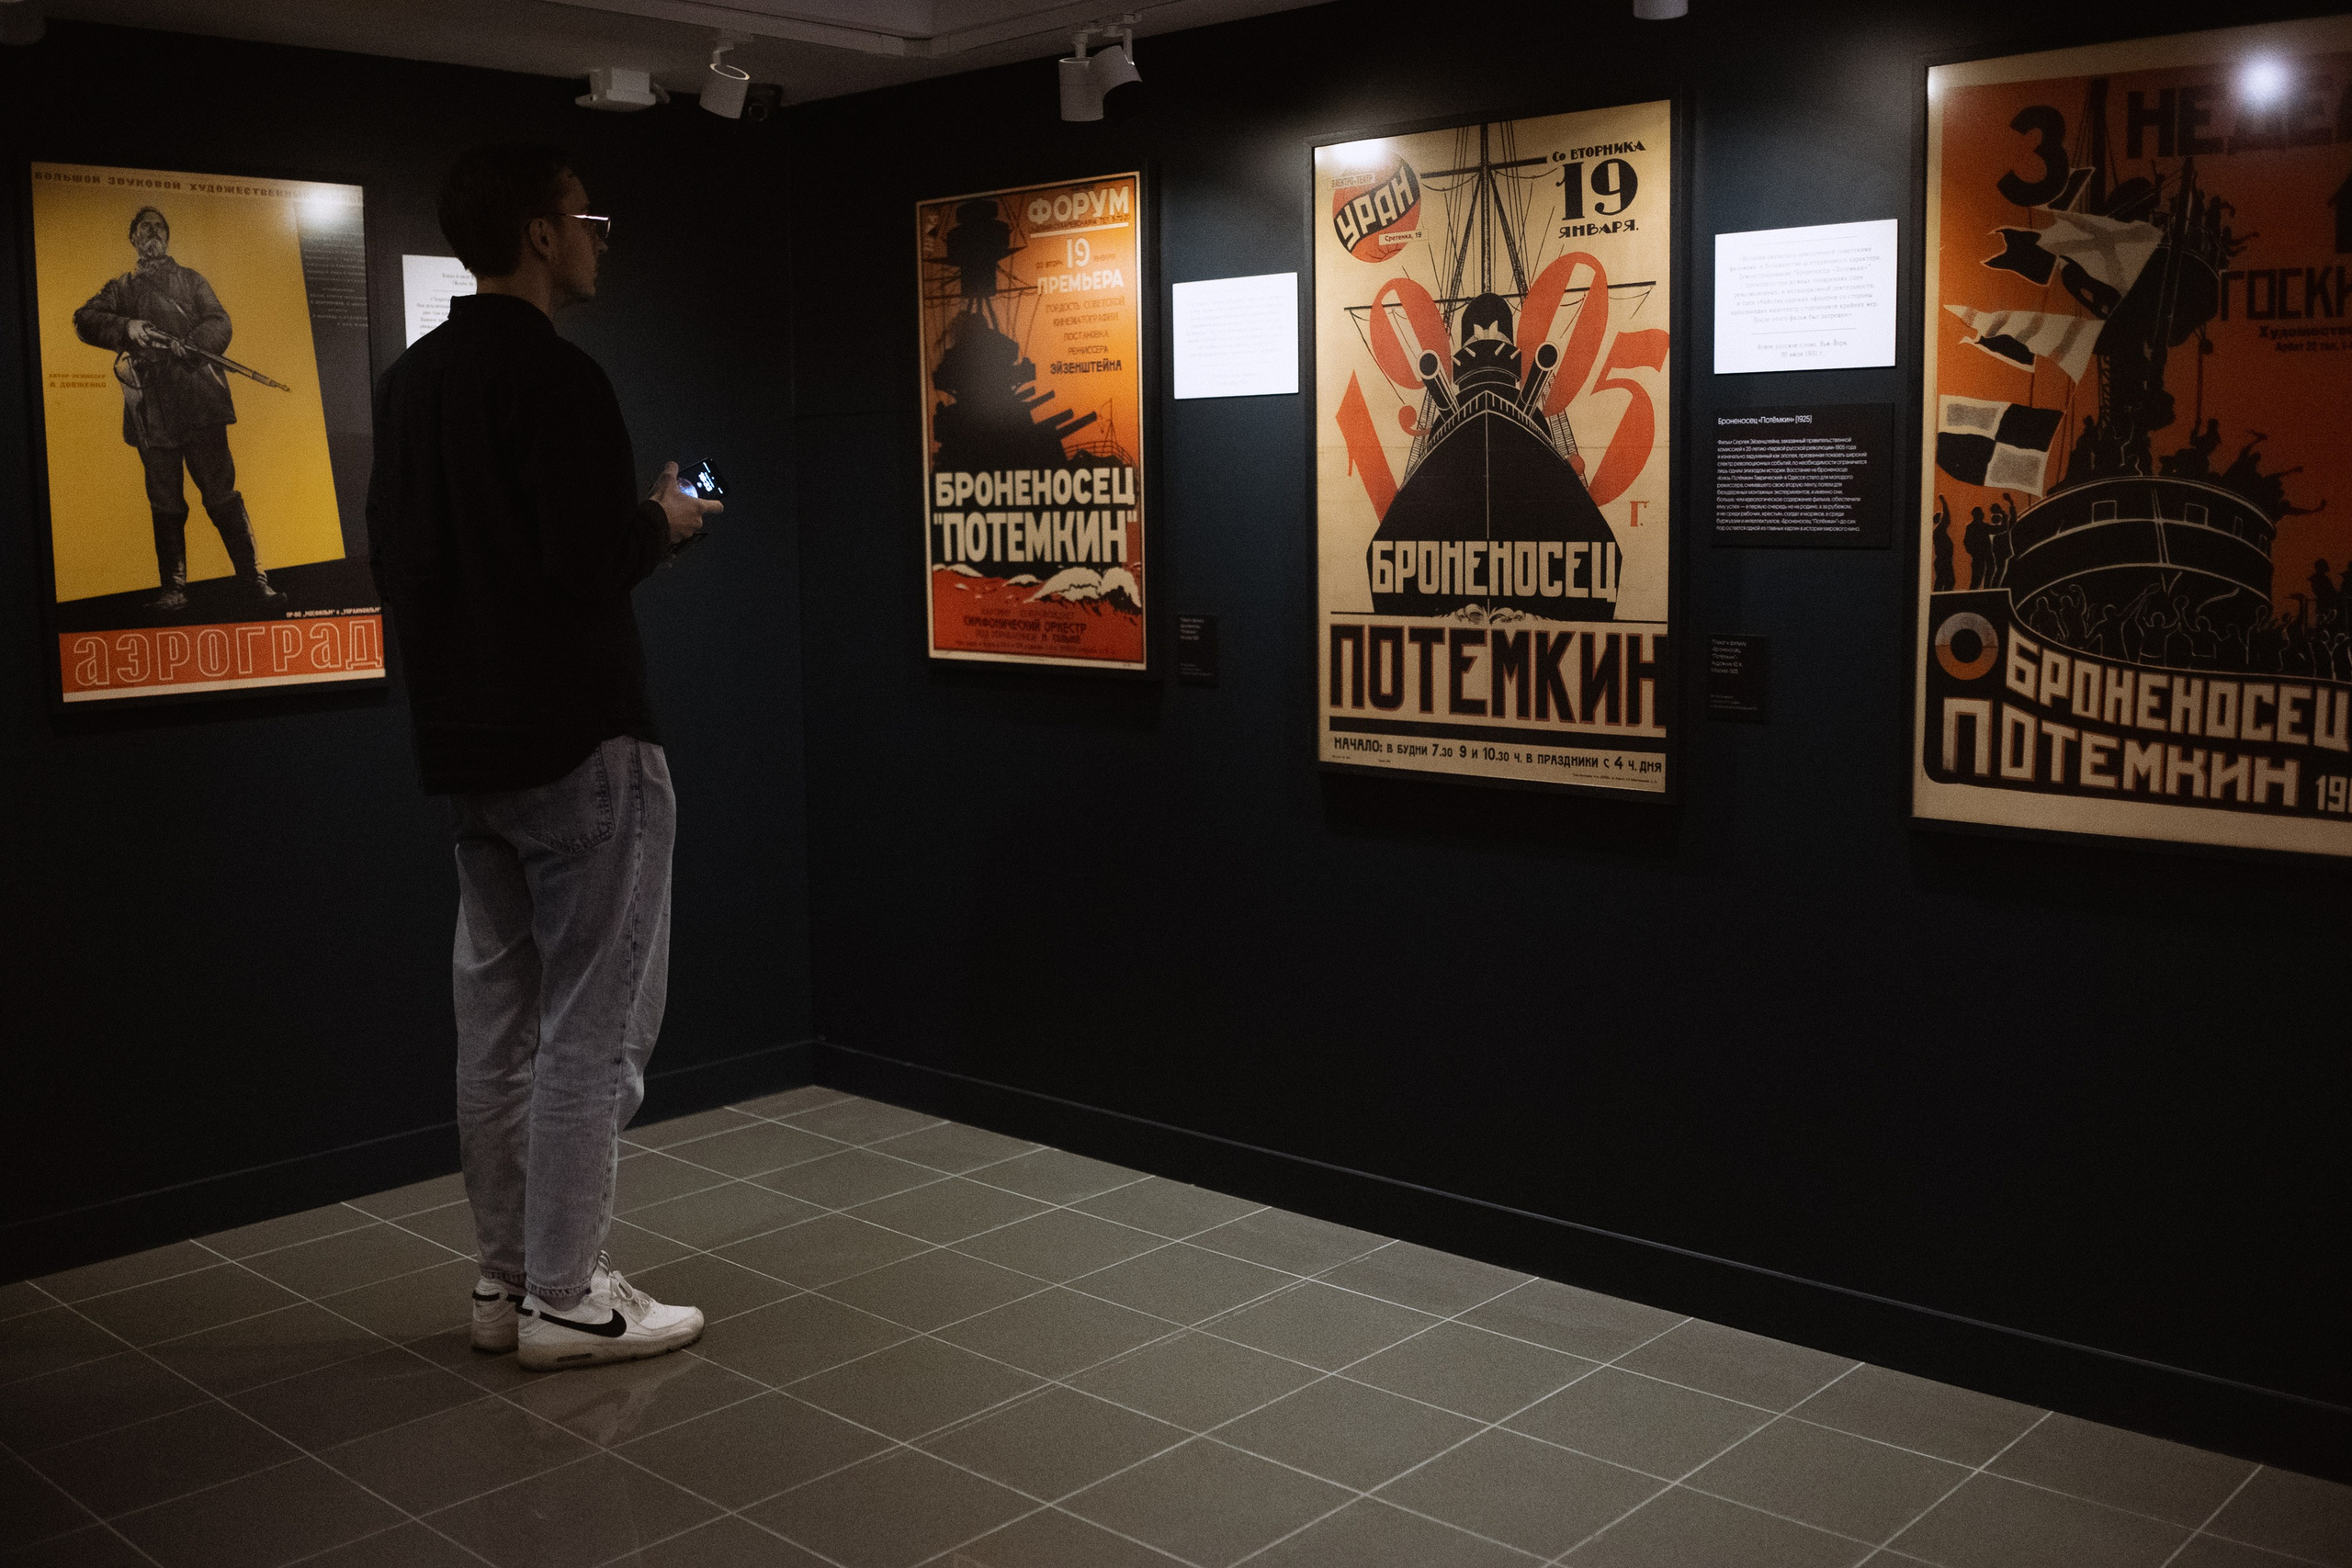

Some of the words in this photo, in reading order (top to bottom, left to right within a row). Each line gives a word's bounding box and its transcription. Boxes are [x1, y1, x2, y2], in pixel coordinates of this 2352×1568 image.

[1570, 141, 1646, 161] ВТОРНИКА
[1028, 186, 1129, 225] ФОРУМ
[1335, 165, 1415, 250] УРАН
[1555, 158, 1638, 220] 19
[1558, 219, 1639, 239] ЯНВАРЯ.
[1067, 237, 1091, 268] 19
[1037, 268, 1125, 294] ПРЕМЬЕРА
[1050, 358, 1122, 375] ЭЙЗЕНШТЕЙНА
[1718, 417, 1758, 425] Броненосец
[1758, 415, 1793, 423] «Потёмкин»
[935, 467, 1136, 507] БРОНЕНОСЕЦ
[933, 510, 1137, 563] "ПОТЕМКИН"
[1372, 540, 1617, 603] БРОНЕНОСЕЦ
[1329, 623, 1668, 729] ПОТЕМКИН
[2006, 621, 2350, 752] БРОНЕНОСЕЦ
[1334, 737, 1383, 753] НАЧАЛО:
[1396, 744, 1428, 757] БУДНИ
[1431, 743, 1453, 758] 7.30
[1459, 745, 1467, 758] 9
[1482, 746, 1510, 761] 10.30
[1537, 753, 1599, 768] ПРАЗДНИКИ
[1613, 755, 1623, 770] 4
[1639, 761, 1663, 773] ДНЯ
[1942, 696, 2300, 807] ПОТЕМКИН
[2315, 774, 2352, 813] 19
